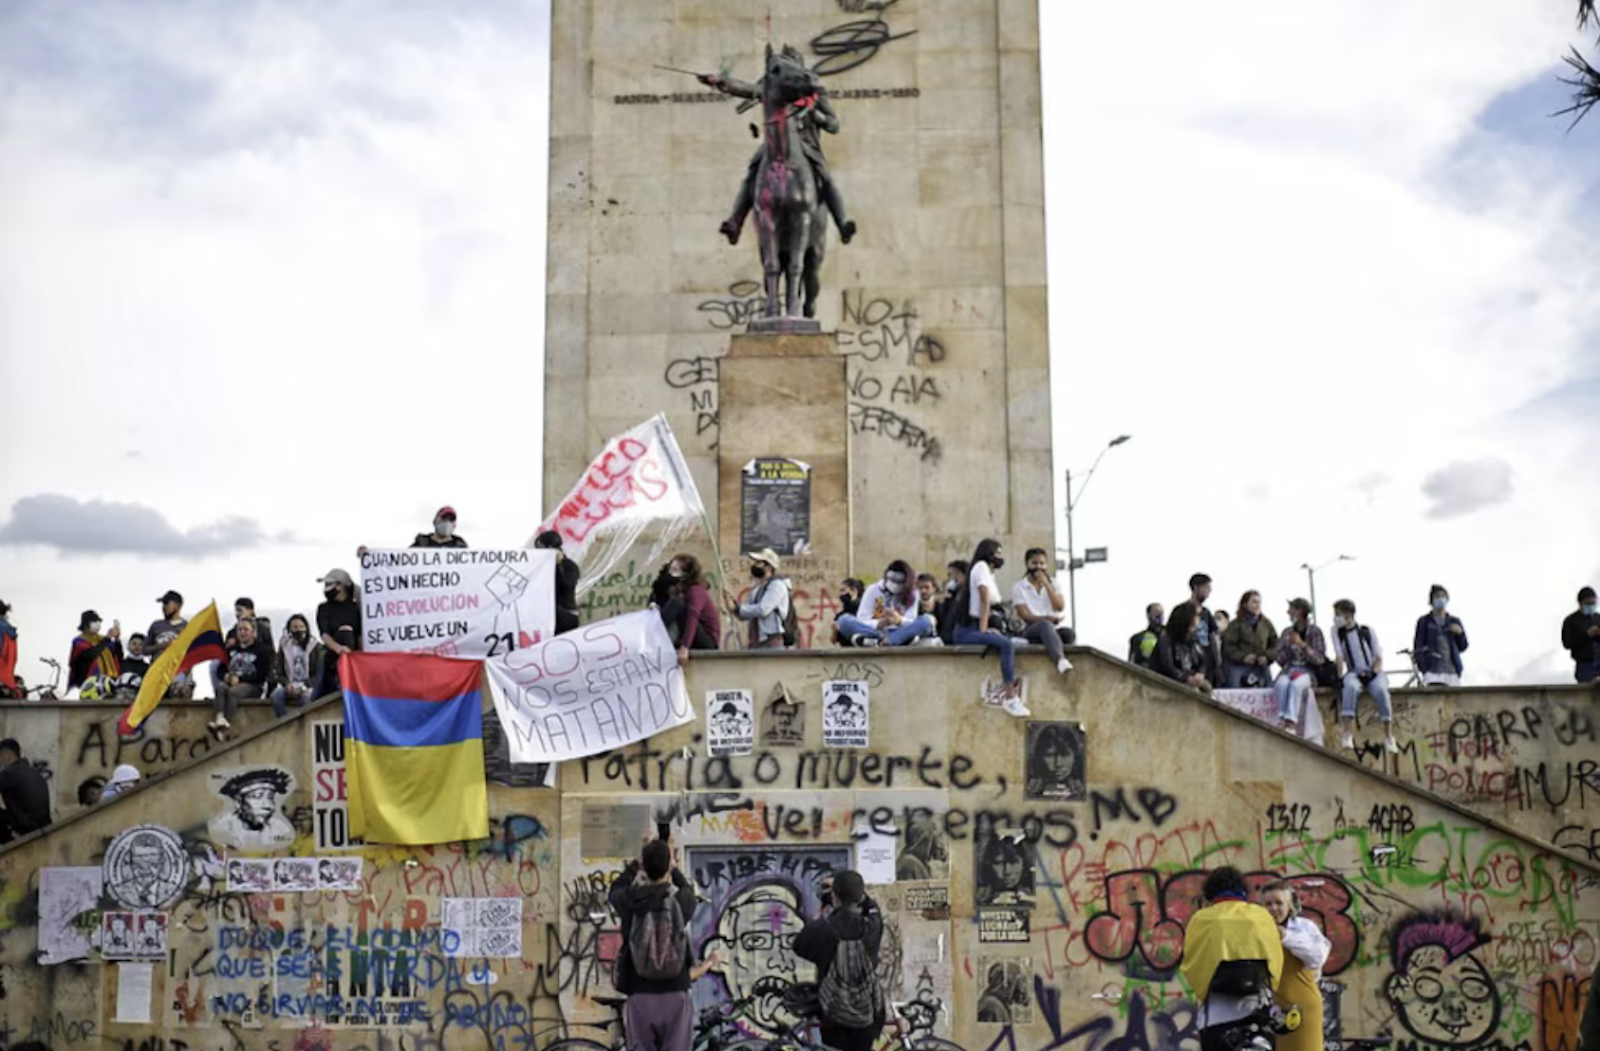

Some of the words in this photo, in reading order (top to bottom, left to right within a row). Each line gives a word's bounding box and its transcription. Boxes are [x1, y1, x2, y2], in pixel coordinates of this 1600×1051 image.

[361, 552, 418, 568] CUANDO
[423, 552, 441, 565] LA
[446, 550, 529, 564] DICTADURA
[365, 577, 383, 594] ES
[387, 574, 408, 591] UN
[411, 572, 460, 589] HECHO
[366, 603, 385, 618] LA
[367, 629, 383, 644] SE
[387, 622, 445, 641] VUELVE
[447, 621, 468, 636] UN
[503, 679, 578, 712] NOS
[586, 647, 662, 695] ESTAN
[511, 665, 688, 753] MATANDO
[754, 751, 781, 784] o
[1266, 803, 1311, 832] 1312
[1368, 803, 1415, 837] ACAB
[216, 954, 265, 978] QUE
